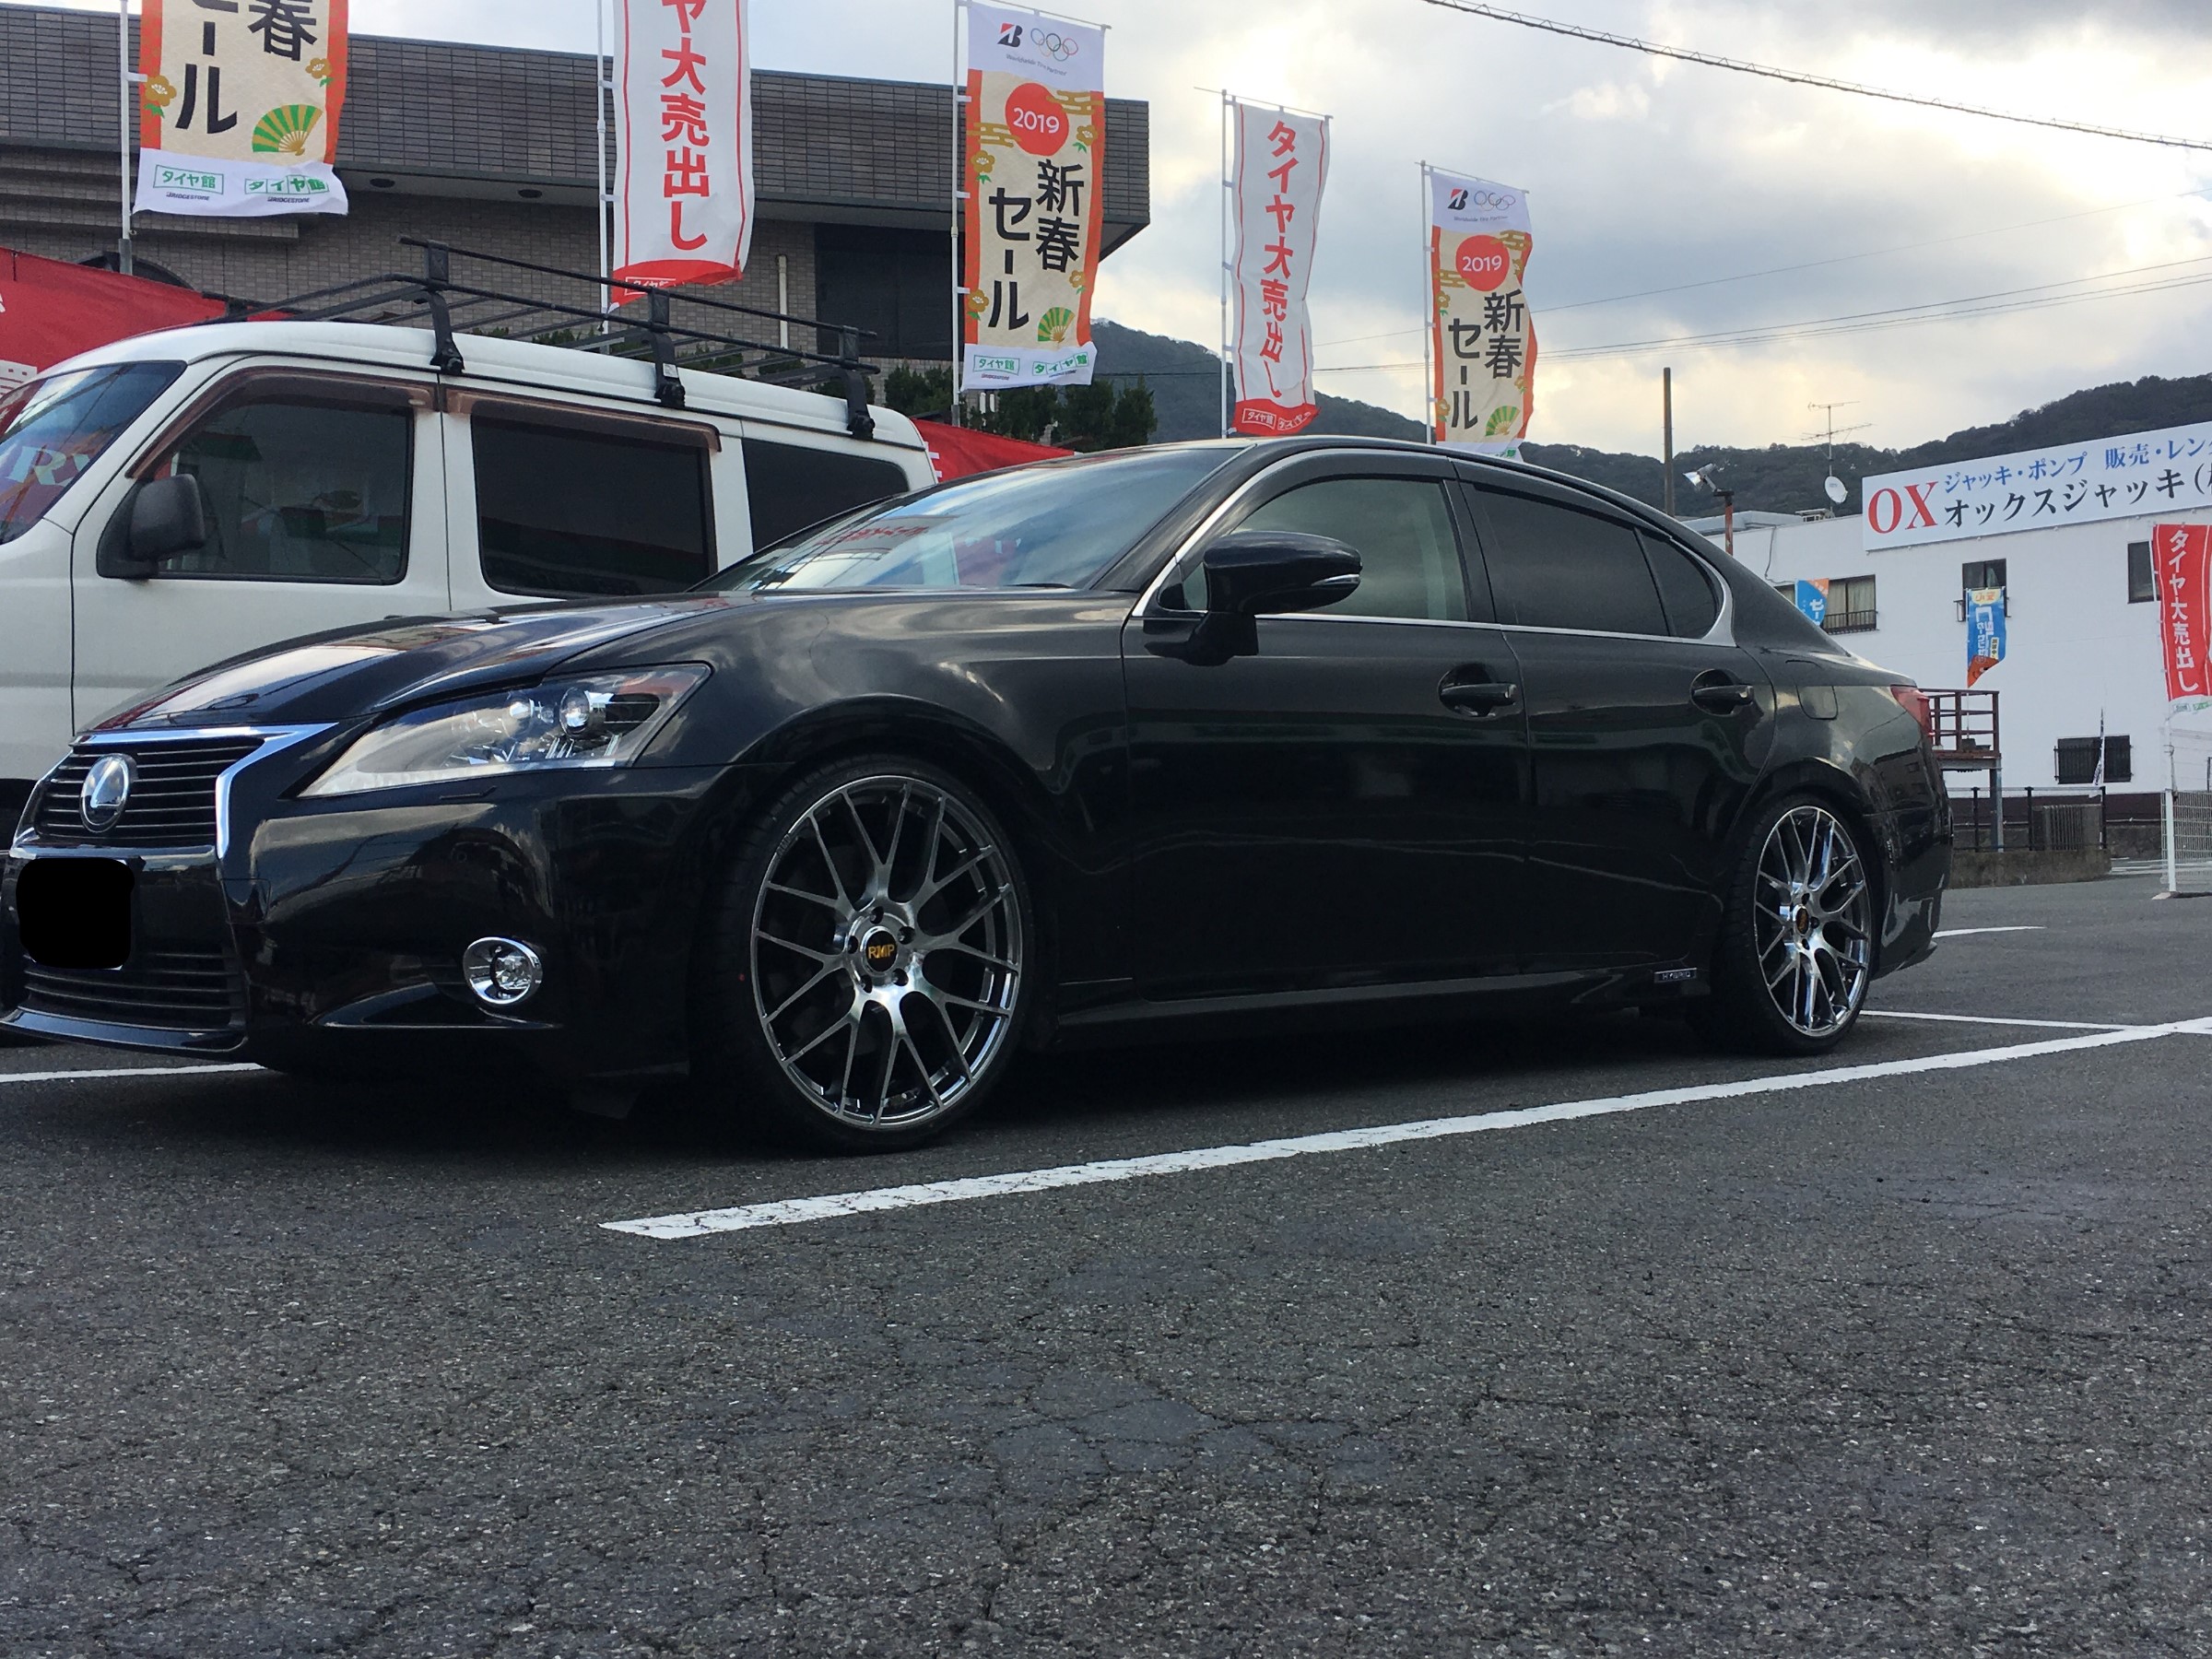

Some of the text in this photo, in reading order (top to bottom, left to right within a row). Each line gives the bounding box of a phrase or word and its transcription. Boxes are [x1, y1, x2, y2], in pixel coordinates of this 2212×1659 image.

[175, 0, 239, 135] ール
[1013, 107, 1060, 134] 2019
[162, 170, 217, 190] タイヤ館
[248, 176, 326, 193] タイヤ館
[1035, 159, 1085, 273] 新春
[988, 187, 1031, 331] セール
[1260, 119, 1300, 398] タイヤ大売出し
[1462, 254, 1502, 272] 2019
[1484, 288, 1525, 379] 新春
[979, 359, 1015, 371] タイヤ館
[1034, 354, 1088, 374] タイヤ館
[1448, 318, 1481, 429] セール
[1945, 438, 2212, 494] ジャッキ・ポンプ 販売・レン
[1867, 480, 1938, 535] OX
[2169, 529, 2199, 692] タイヤ大売出し
[867, 944, 895, 959] RMP
